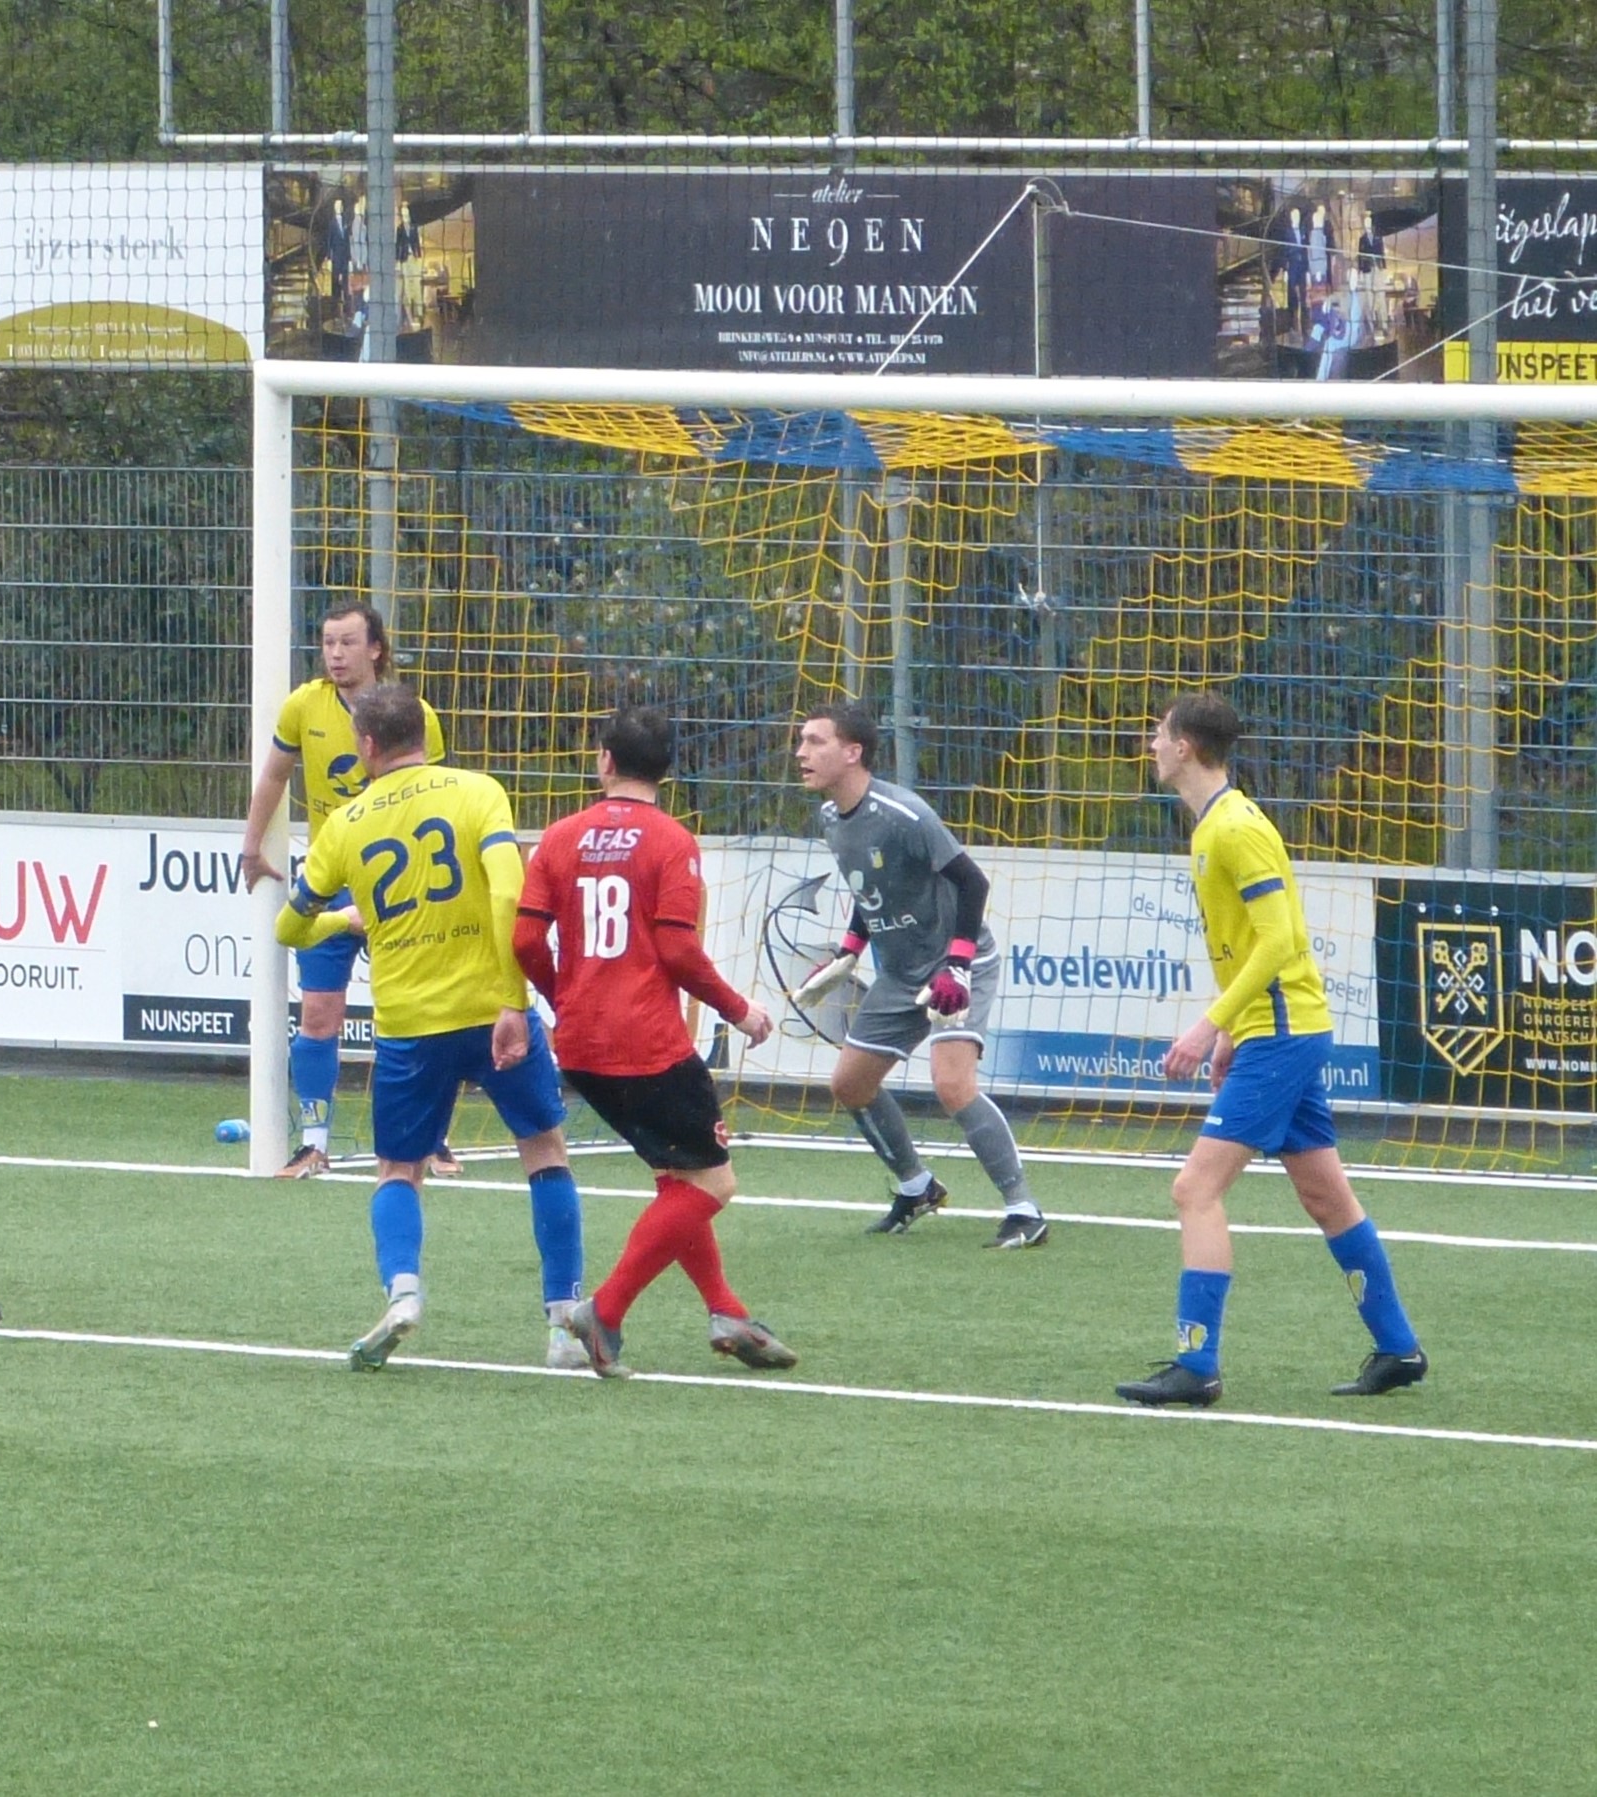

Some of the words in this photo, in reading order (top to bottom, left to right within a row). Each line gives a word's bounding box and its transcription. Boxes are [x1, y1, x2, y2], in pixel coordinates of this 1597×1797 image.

[811, 177, 865, 204] atelier
[24, 225, 185, 271] ijzersterk
[693, 283, 762, 314] MOOI
[773, 283, 845, 315] VOOR
[855, 285, 980, 316] MANNEN
[577, 827, 642, 850] AFAS
[360, 817, 463, 923] 23
[581, 851, 631, 862] software
[576, 875, 630, 958] 18
[422, 929, 447, 944] my
[451, 922, 481, 939] day
[1133, 893, 1155, 917] de
[1323, 977, 1369, 1009] peet!
[1312, 936, 1337, 961] op
[1012, 944, 1192, 1003] Koelewijn
[141, 1008, 235, 1035] NUNSPEET
